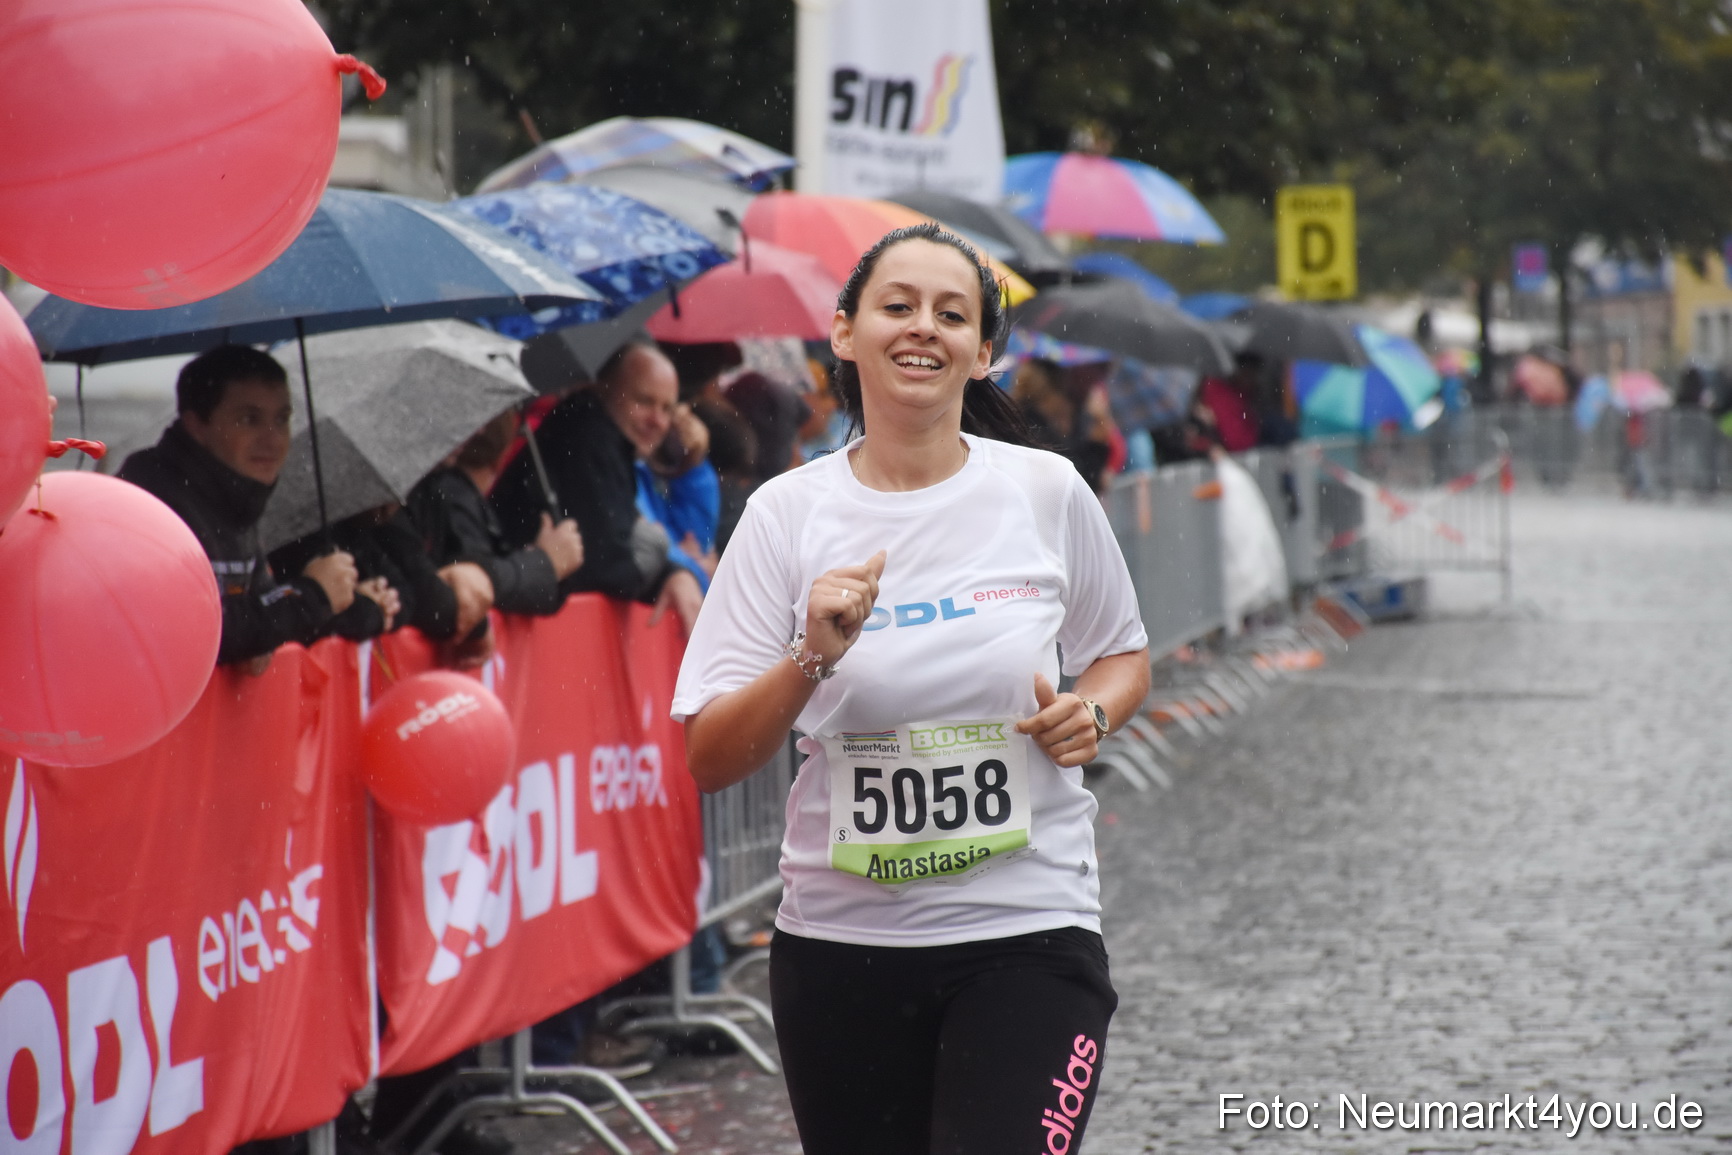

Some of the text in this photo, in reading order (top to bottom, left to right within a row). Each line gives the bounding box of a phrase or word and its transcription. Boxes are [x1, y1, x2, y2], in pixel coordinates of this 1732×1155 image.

[1299, 221, 1334, 273] D
[843, 743, 900, 754] NeuerMarkt
[909, 723, 1007, 751] BOCK
[912, 742, 1009, 759] inspired by smart concepts
[852, 758, 1012, 835] 5058
[866, 845, 991, 880] Anastasia
[1041, 1033, 1098, 1155] didas
